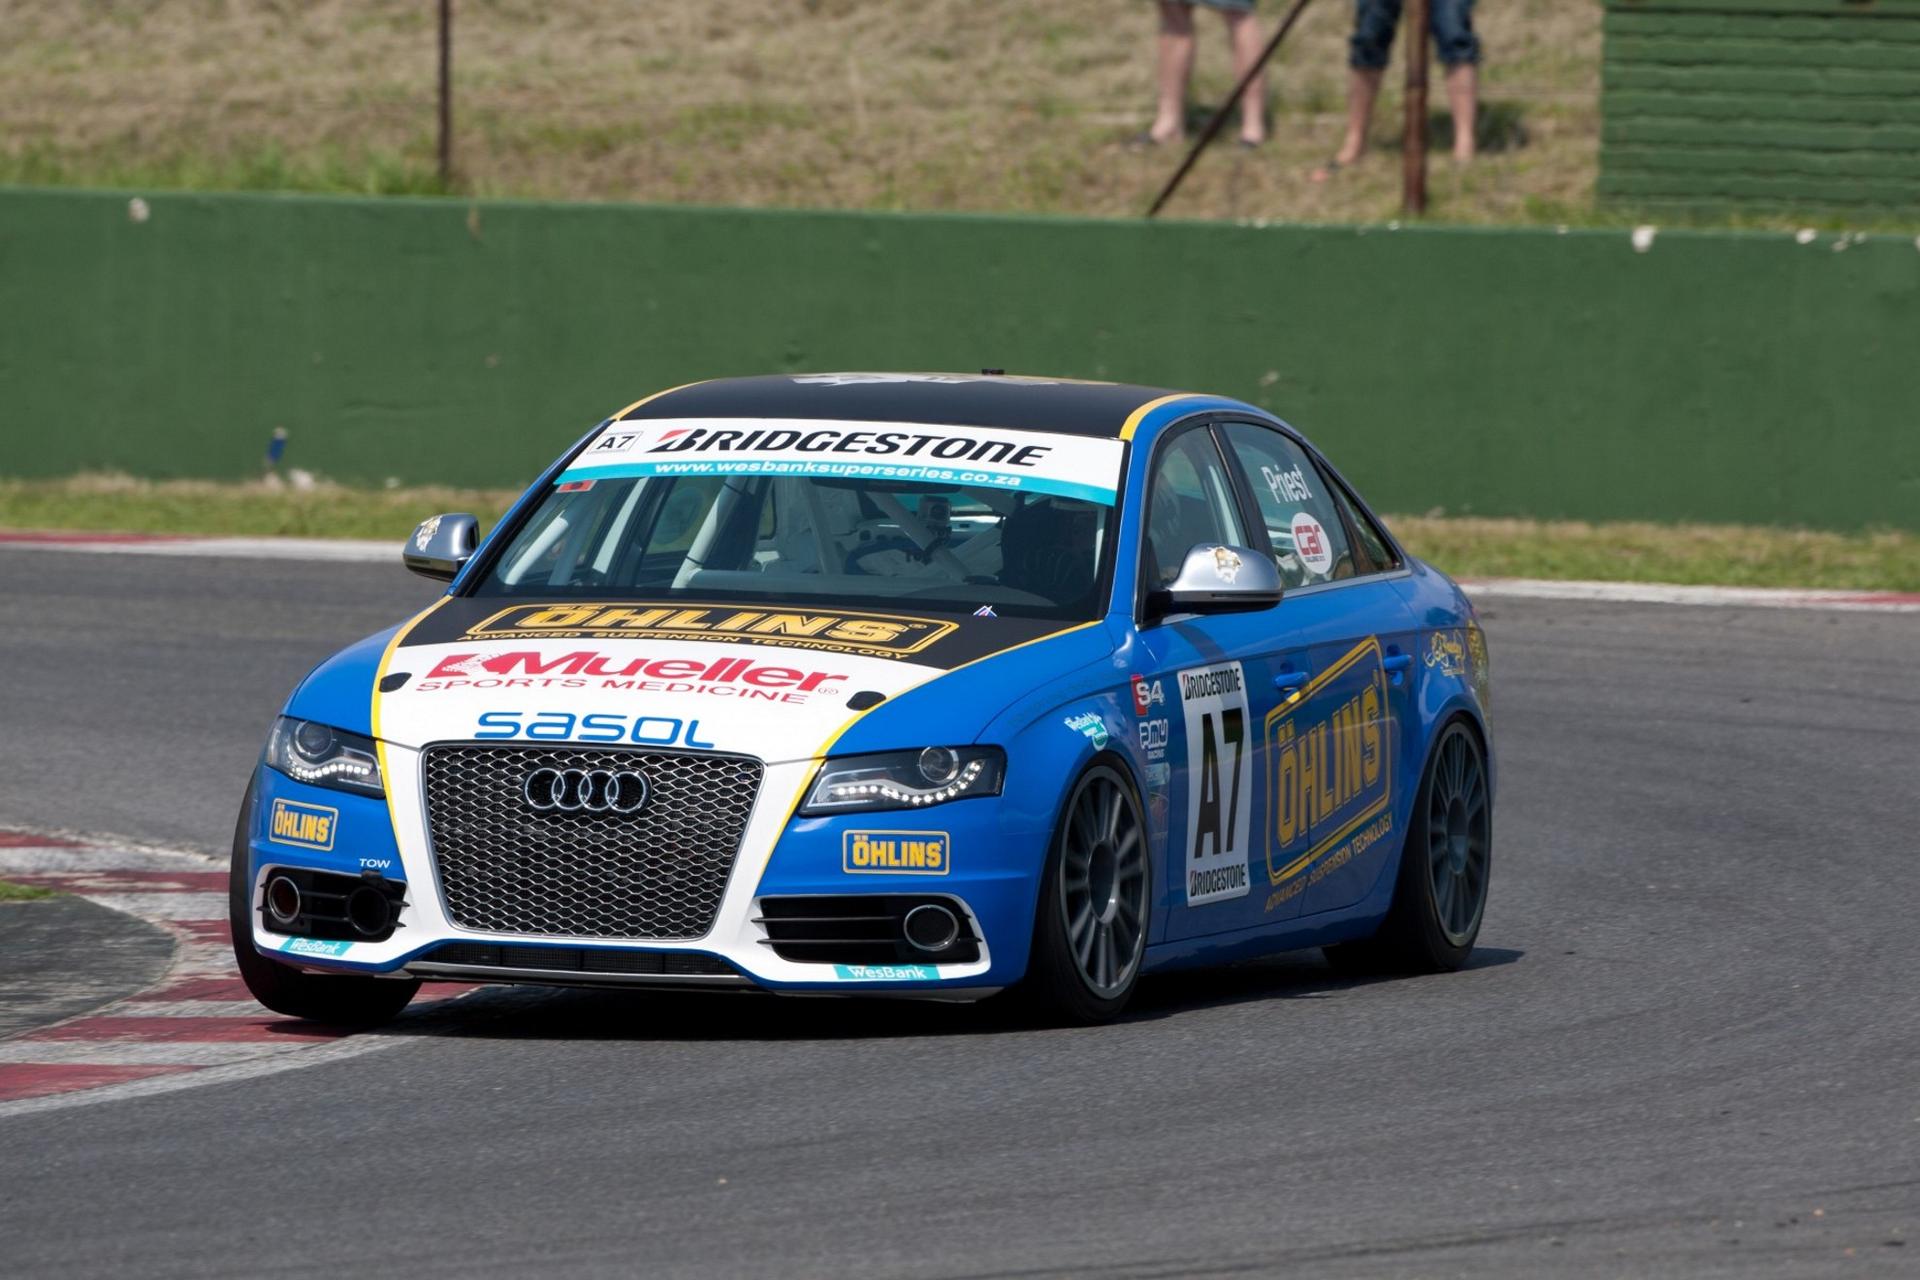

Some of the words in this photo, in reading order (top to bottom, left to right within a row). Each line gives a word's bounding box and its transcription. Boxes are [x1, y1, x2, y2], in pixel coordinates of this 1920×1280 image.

[597, 435, 636, 450] A7
[646, 428, 1052, 467] BRIDGESTONE
[655, 460, 1021, 487] www.wesbanksuperseries.co.za
[1261, 464, 1312, 503] Priest
[515, 605, 911, 642] ÖHLINS
[456, 631, 581, 641] ADVANCED
[592, 631, 739, 643] SUSPENSION
[751, 639, 909, 659] TECHNOLOGY
[481, 651, 848, 692] Mueller
[1182, 668, 1242, 700] BRIDGESTONE
[416, 677, 587, 691] SPORTS
[601, 678, 808, 704] MEDICINE
[1136, 680, 1165, 707] S4
[1194, 707, 1244, 859] A7
[1277, 685, 1380, 848] ÖHLINS
[274, 804, 330, 843] ÖHLINS
[359, 858, 391, 869] TOW
[852, 834, 942, 867] ÖHLINS
[1190, 864, 1246, 897] BRIDGESTONE
[850, 964, 927, 980] WesBank
